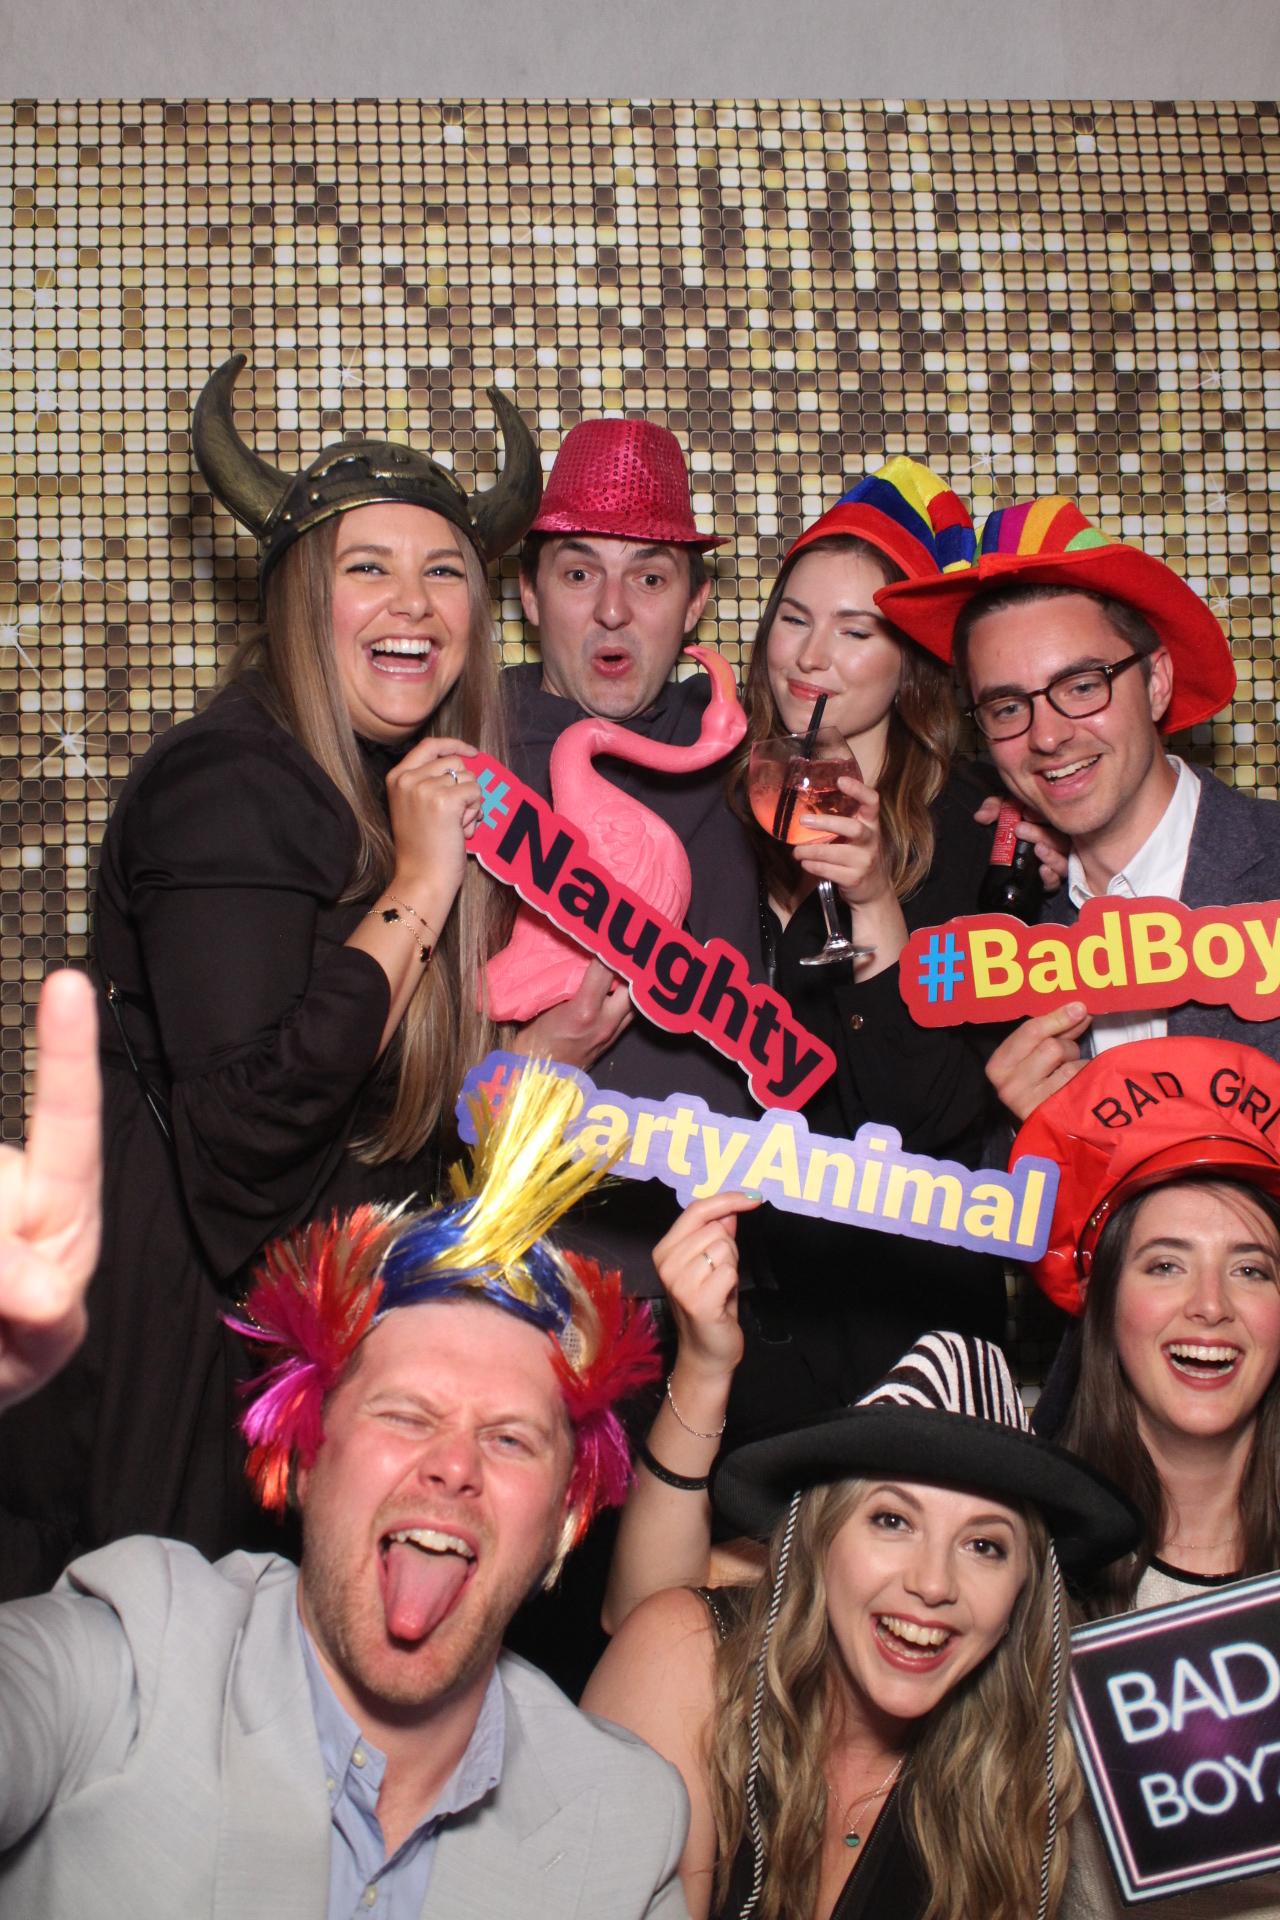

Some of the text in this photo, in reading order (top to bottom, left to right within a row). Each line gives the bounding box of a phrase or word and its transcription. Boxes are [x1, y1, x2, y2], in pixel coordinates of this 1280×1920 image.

[477, 768, 823, 1096] #Naughty
[472, 1065, 1046, 1247] #artyAnimal
[1092, 1071, 1184, 1128] BAD
[1107, 1642, 1280, 1744] BAD
